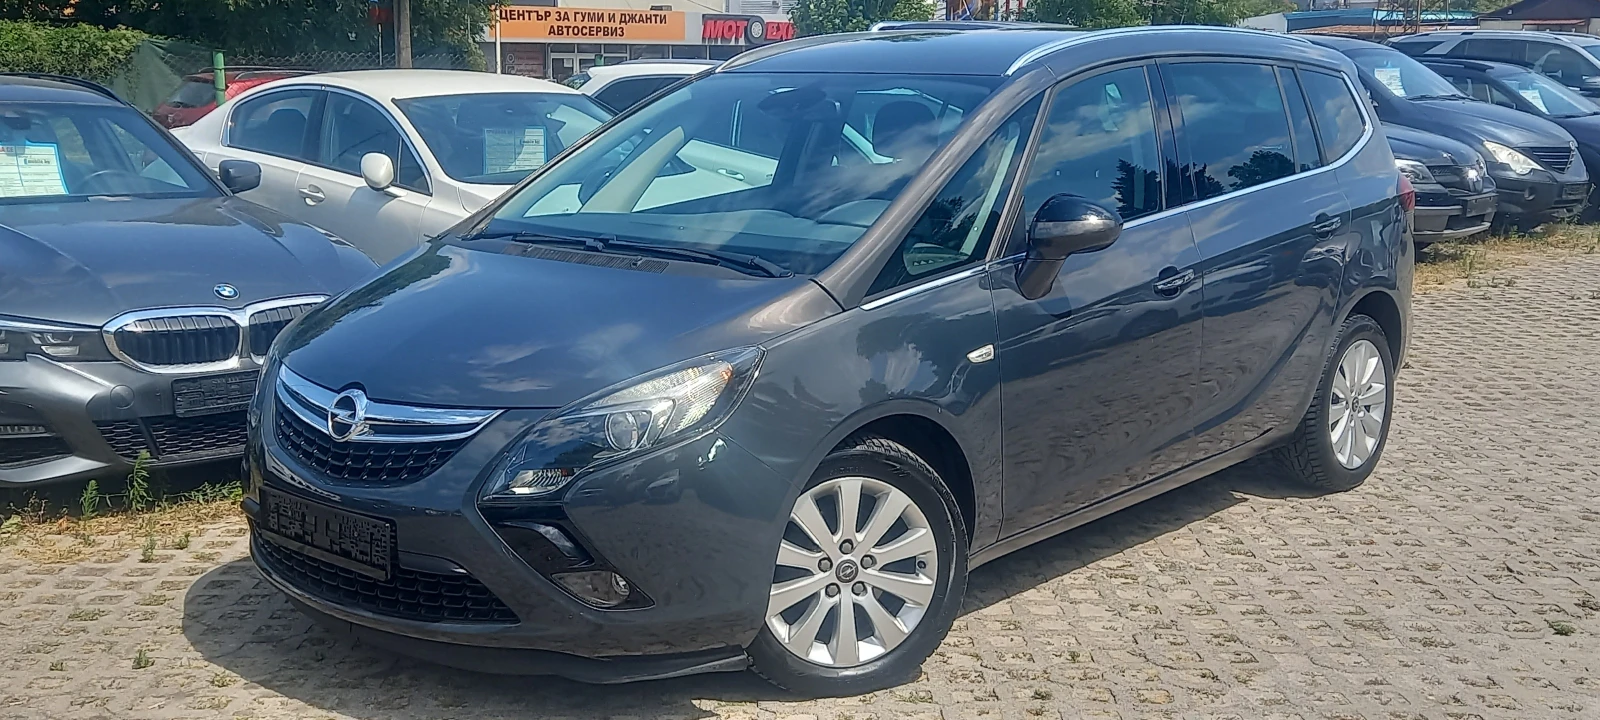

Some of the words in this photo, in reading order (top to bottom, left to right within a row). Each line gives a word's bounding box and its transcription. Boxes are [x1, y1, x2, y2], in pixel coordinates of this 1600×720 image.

[499, 9, 552, 22] ЦЕНТЪР
[555, 11, 570, 22] ЗА
[573, 11, 605, 23] ГУМИ
[608, 12, 616, 23] И
[618, 13, 667, 25] ДЖАНТИ
[547, 25, 625, 37] АВТОСЕРВИЗ
